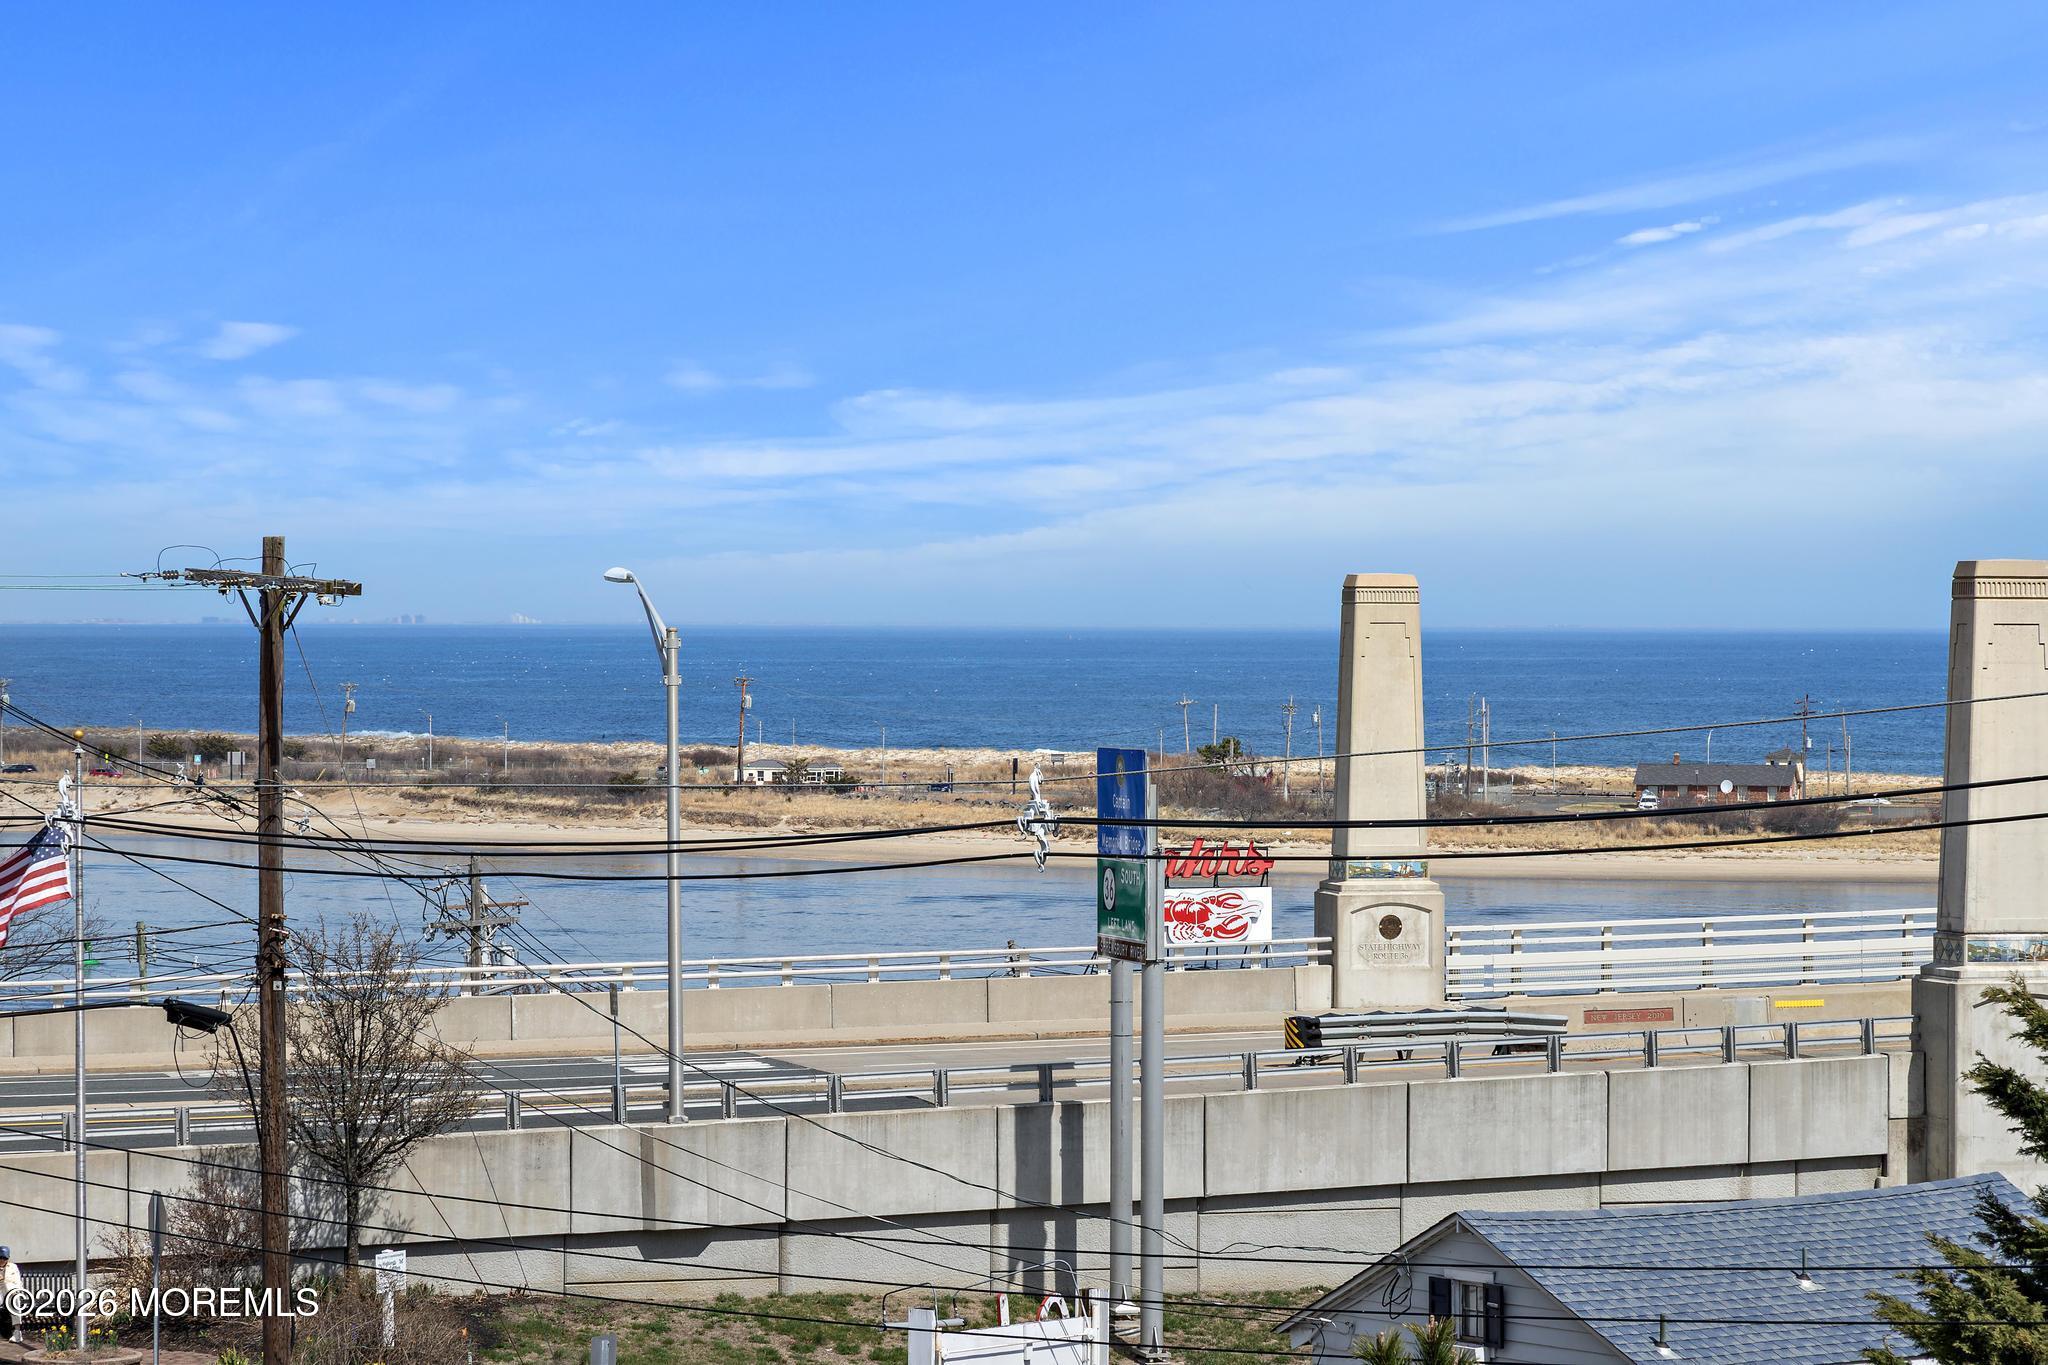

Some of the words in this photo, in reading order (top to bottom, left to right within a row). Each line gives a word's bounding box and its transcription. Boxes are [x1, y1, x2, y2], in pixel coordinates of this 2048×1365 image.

[1120, 868, 1141, 887] SOUTH
[1104, 878, 1114, 900] 36
[1107, 916, 1120, 930] LEFT
[1121, 919, 1135, 933] LANE
[1373, 952, 1399, 960] ROUTE
[1400, 952, 1409, 960] 36
[1614, 1012, 1641, 1020] JERSEY
